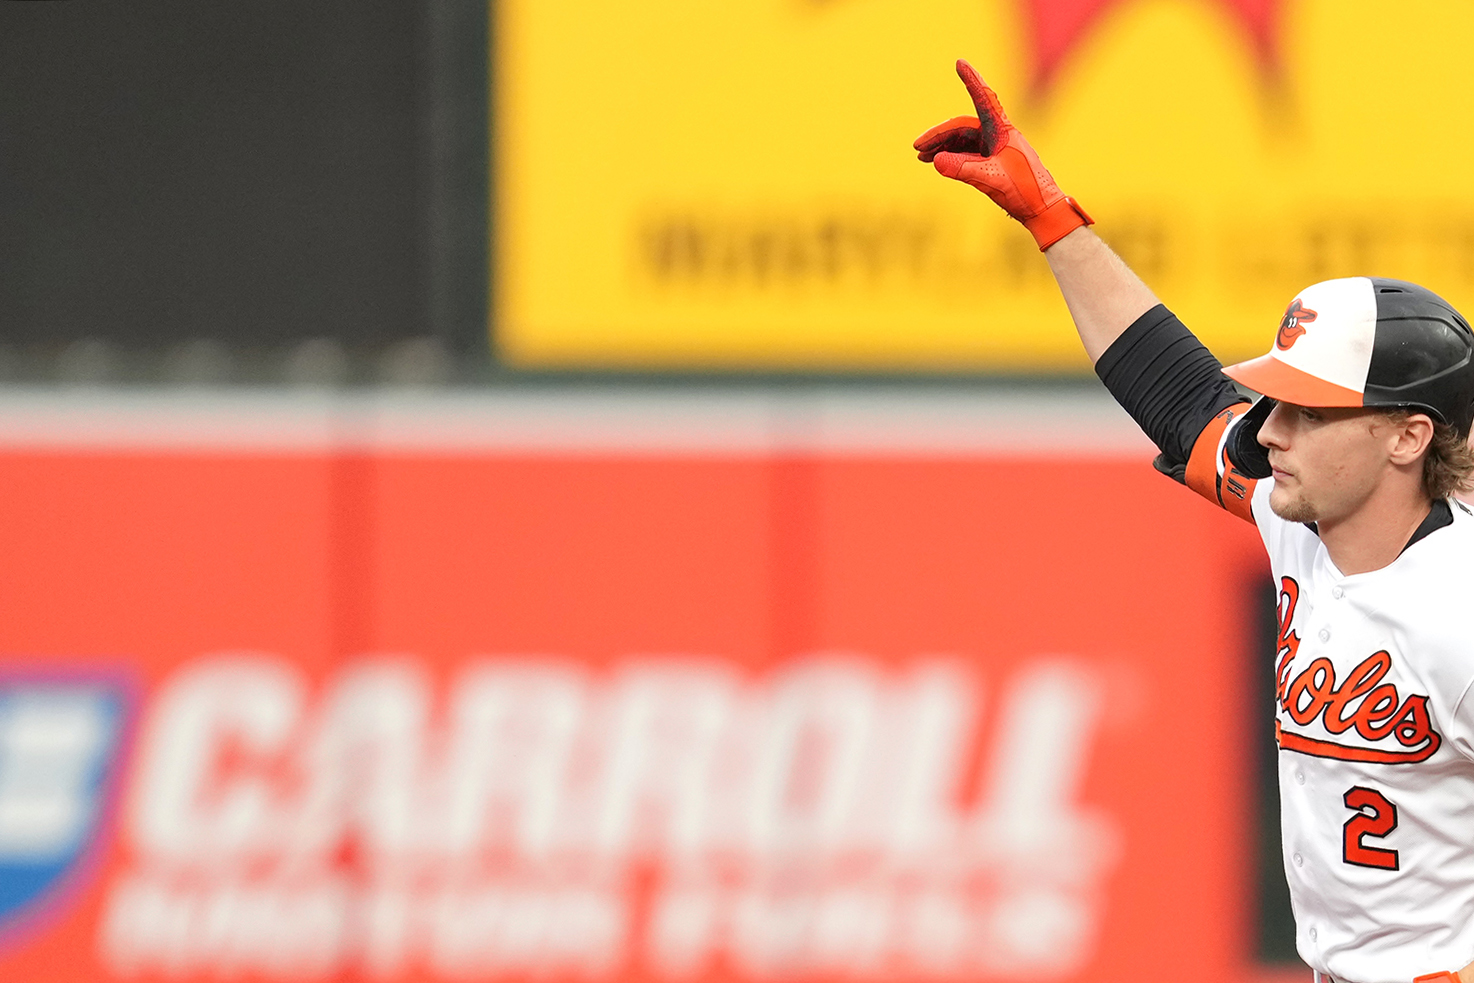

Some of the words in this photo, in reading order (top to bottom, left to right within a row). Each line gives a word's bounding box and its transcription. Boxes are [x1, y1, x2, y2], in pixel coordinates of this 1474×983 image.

[638, 212, 1170, 290] MARYLAD
[1275, 576, 1442, 757] roles
[132, 658, 1120, 862] CARROLL
[1342, 785, 1399, 871] 2
